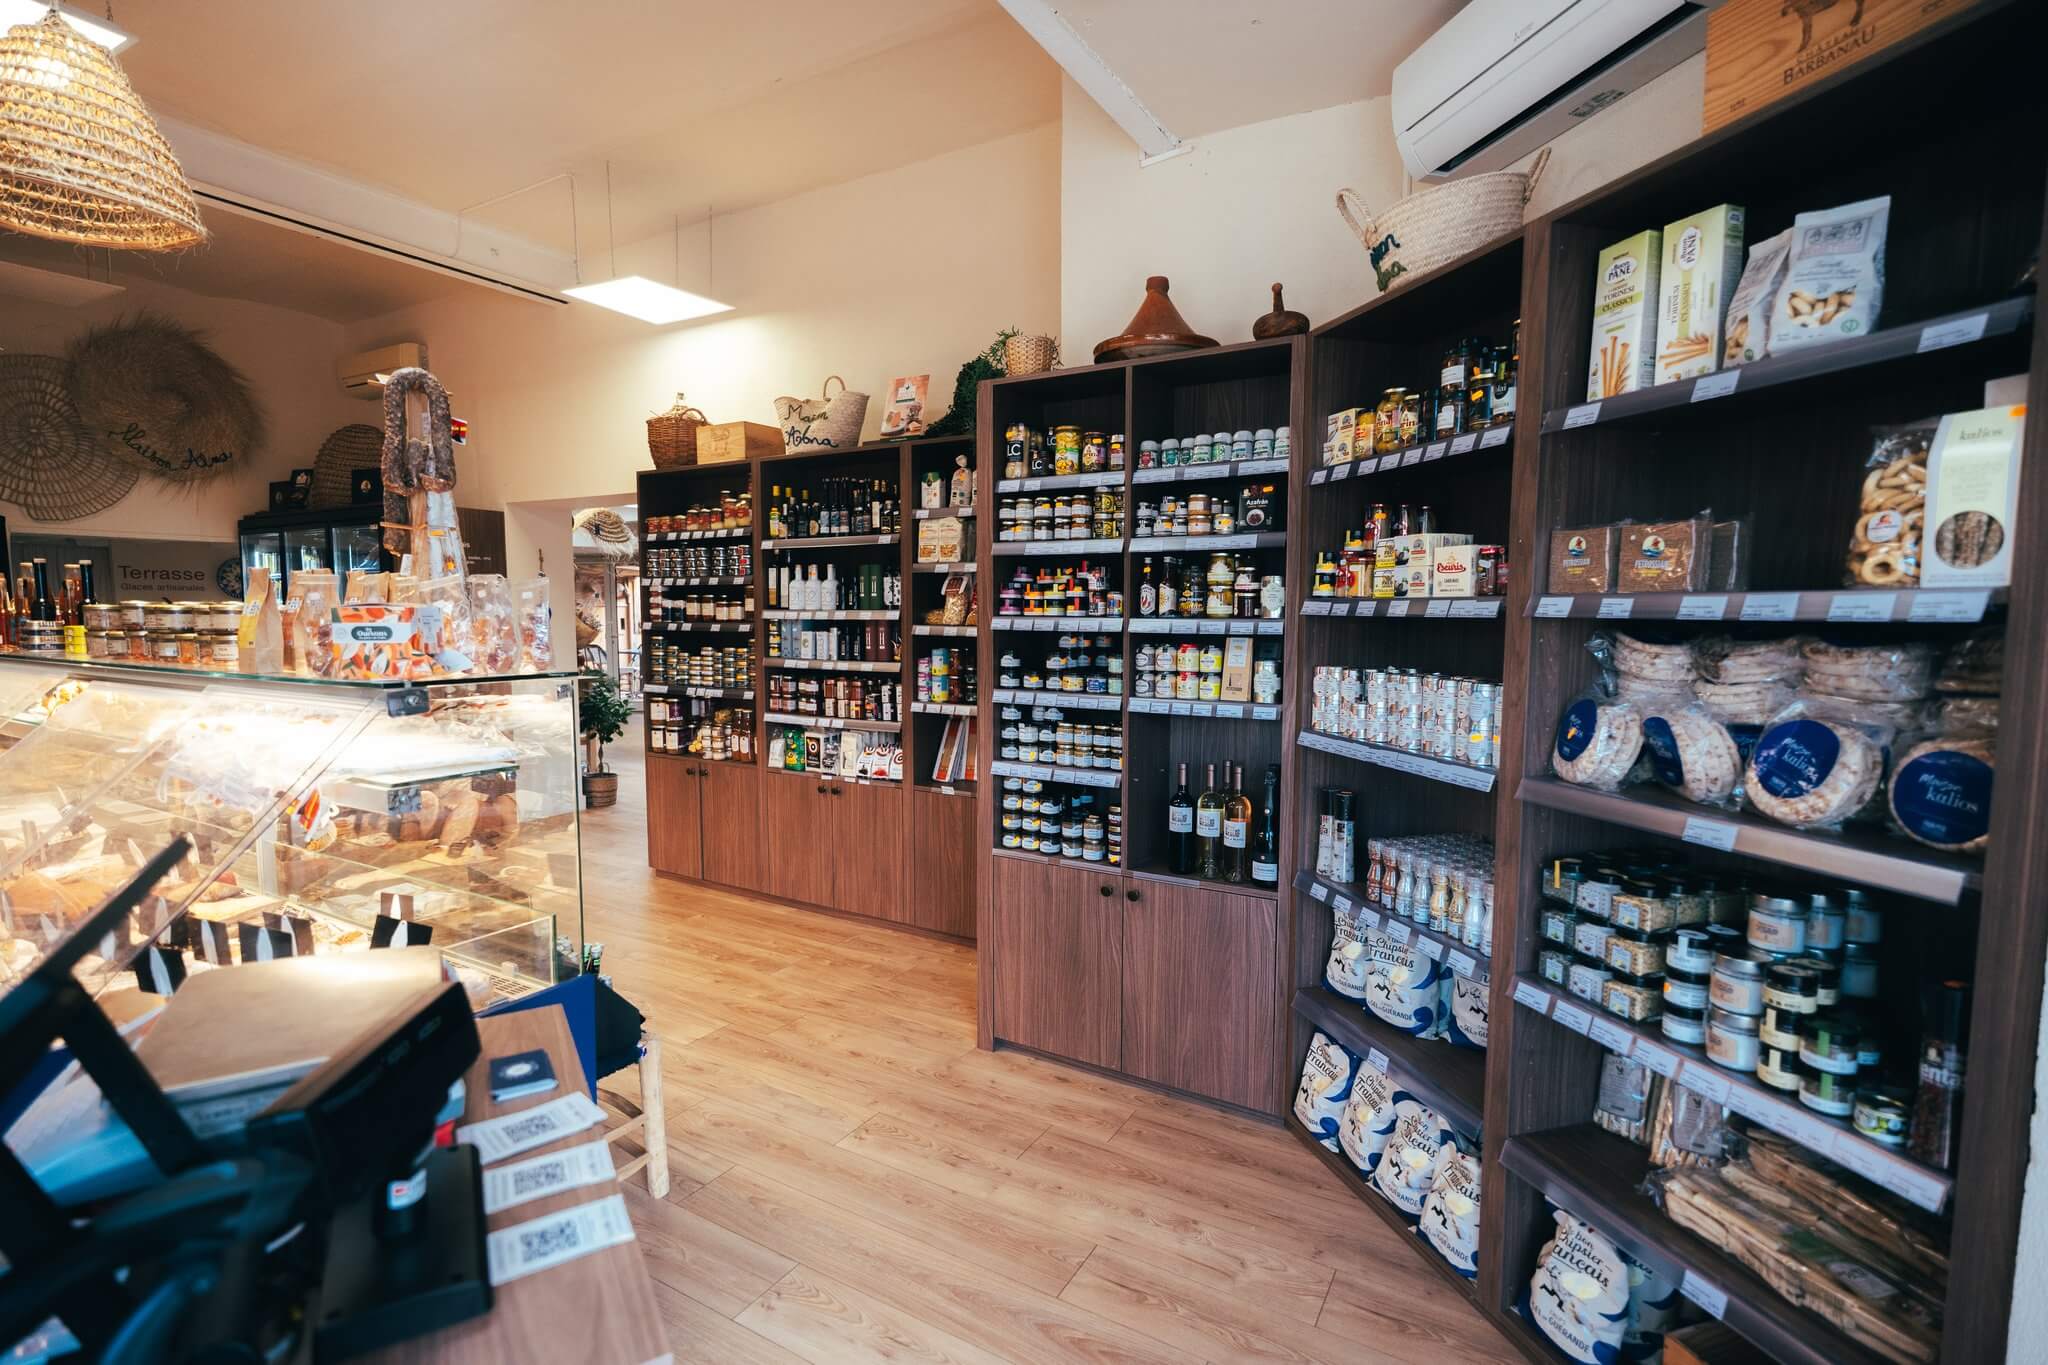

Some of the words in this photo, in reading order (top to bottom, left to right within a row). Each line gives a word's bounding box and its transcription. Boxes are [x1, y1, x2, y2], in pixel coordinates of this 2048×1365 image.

[1783, 24, 1876, 85] BARBANAU
[1608, 266, 1632, 281] PANE
[118, 565, 205, 581] Terrasse
[1926, 787, 1979, 814] kalios
